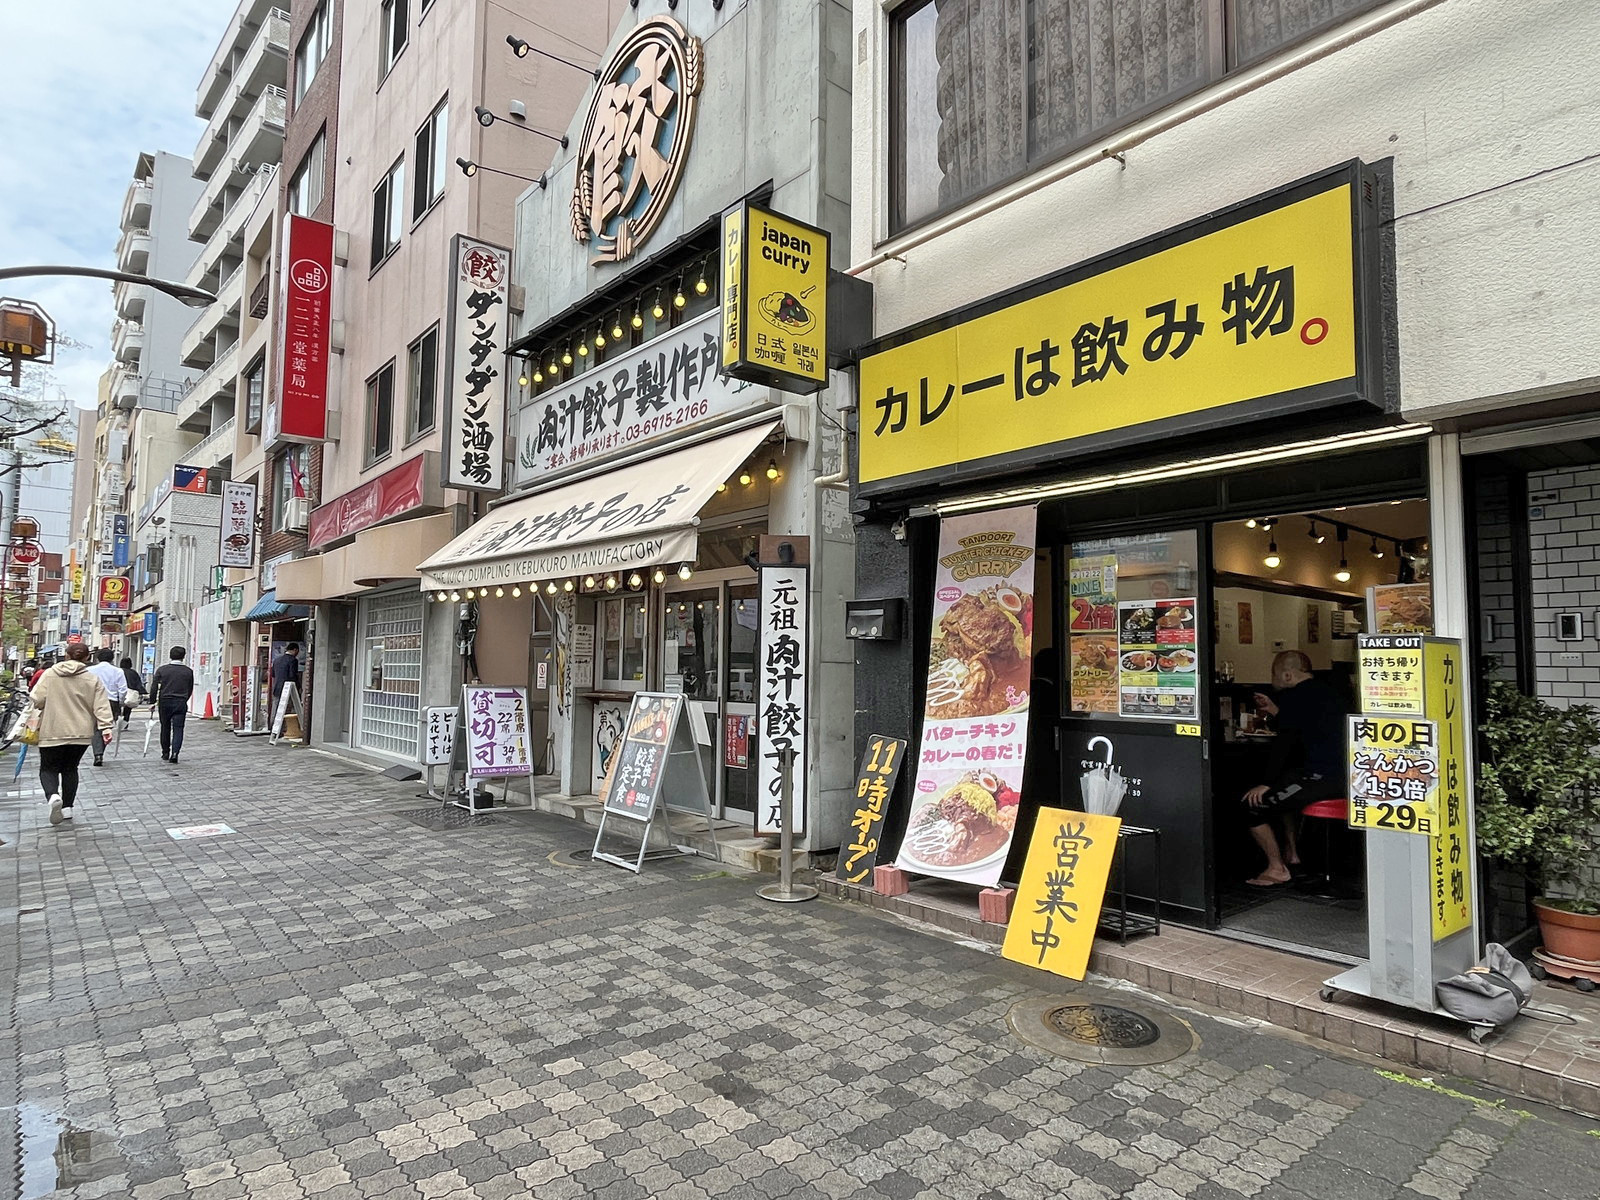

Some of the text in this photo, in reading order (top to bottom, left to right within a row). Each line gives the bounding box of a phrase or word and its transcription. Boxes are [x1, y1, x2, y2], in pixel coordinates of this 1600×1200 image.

[581, 43, 676, 237] 餃
[761, 222, 811, 255] japan
[467, 251, 498, 283] 餃
[761, 245, 810, 274] curry
[291, 296, 311, 389] 一二三堂薬局
[757, 333, 787, 352] 日式
[792, 342, 819, 360] 일본식
[874, 265, 1330, 437] カレーは飲み物。
[797, 357, 815, 374] 카레
[460, 289, 503, 485] ダンダダン酒場
[626, 399, 708, 441] 03-6915-2166
[469, 485, 691, 556] 肉汁餃子の店
[959, 533, 1013, 547] TANDOORI
[468, 563, 510, 582] DUMPLING
[513, 555, 567, 576] IKEBUKURO
[571, 539, 664, 569] MANUFACTORY
[952, 560, 1020, 580] CURRY
[103, 592, 125, 601] Daily
[1072, 580, 1101, 595] LINE
[1071, 598, 1117, 630] 2倍
[1360, 638, 1419, 647] TAKE OUT
[1362, 657, 1418, 668] お持ち帰り
[1368, 671, 1414, 681] できます
[430, 713, 440, 760] 文化です。
[443, 712, 453, 754] ビールは
[470, 690, 497, 766] 貸切可
[925, 722, 1016, 741] バターチキン
[1180, 725, 1197, 734] 入口
[1353, 719, 1433, 747] 肉の日
[630, 747, 647, 788] 餃子
[1354, 752, 1435, 774] とんかつ
[615, 764, 632, 803] 定食
[845, 739, 899, 883] 11時オープン
[1031, 821, 1093, 965] 営業中
